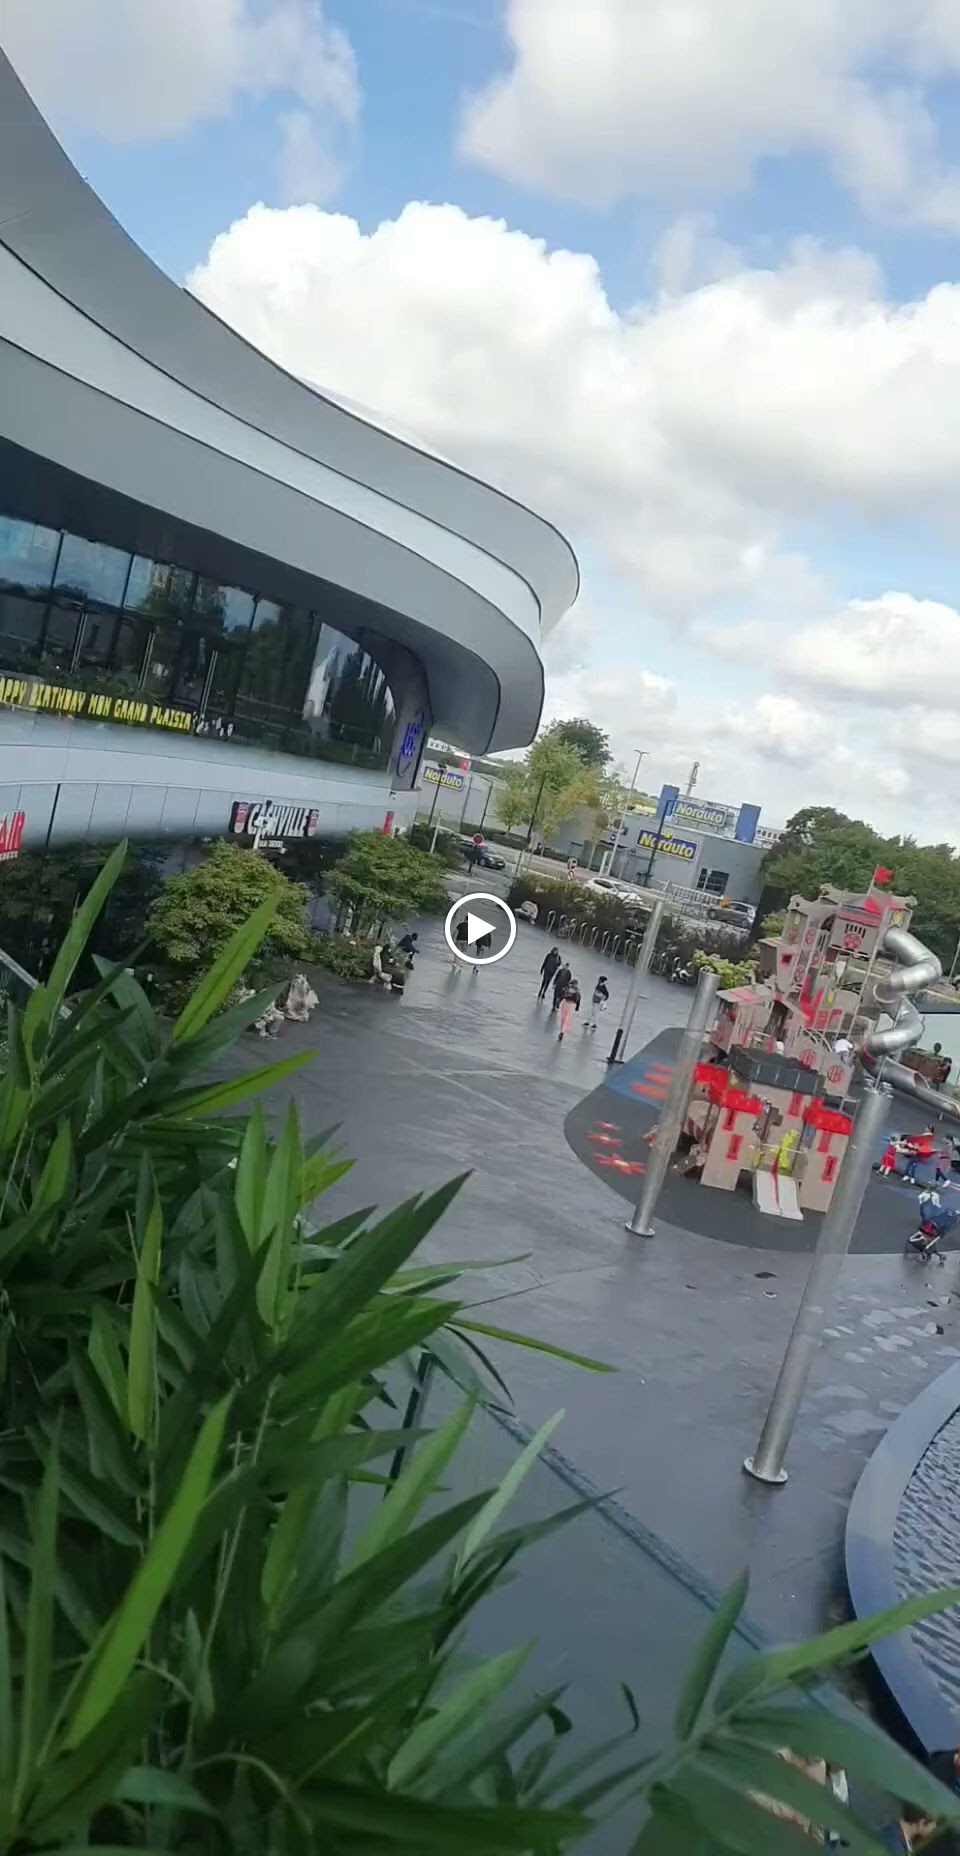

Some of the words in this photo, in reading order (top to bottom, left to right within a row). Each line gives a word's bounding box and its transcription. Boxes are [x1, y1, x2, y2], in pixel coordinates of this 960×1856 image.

[29, 683, 86, 712] BIRTHDAY
[88, 693, 112, 716] MON
[113, 698, 148, 722] GRAND
[150, 705, 192, 731] PLAISIR
[676, 803, 723, 823] Norauto
[640, 832, 694, 858] Norauto
